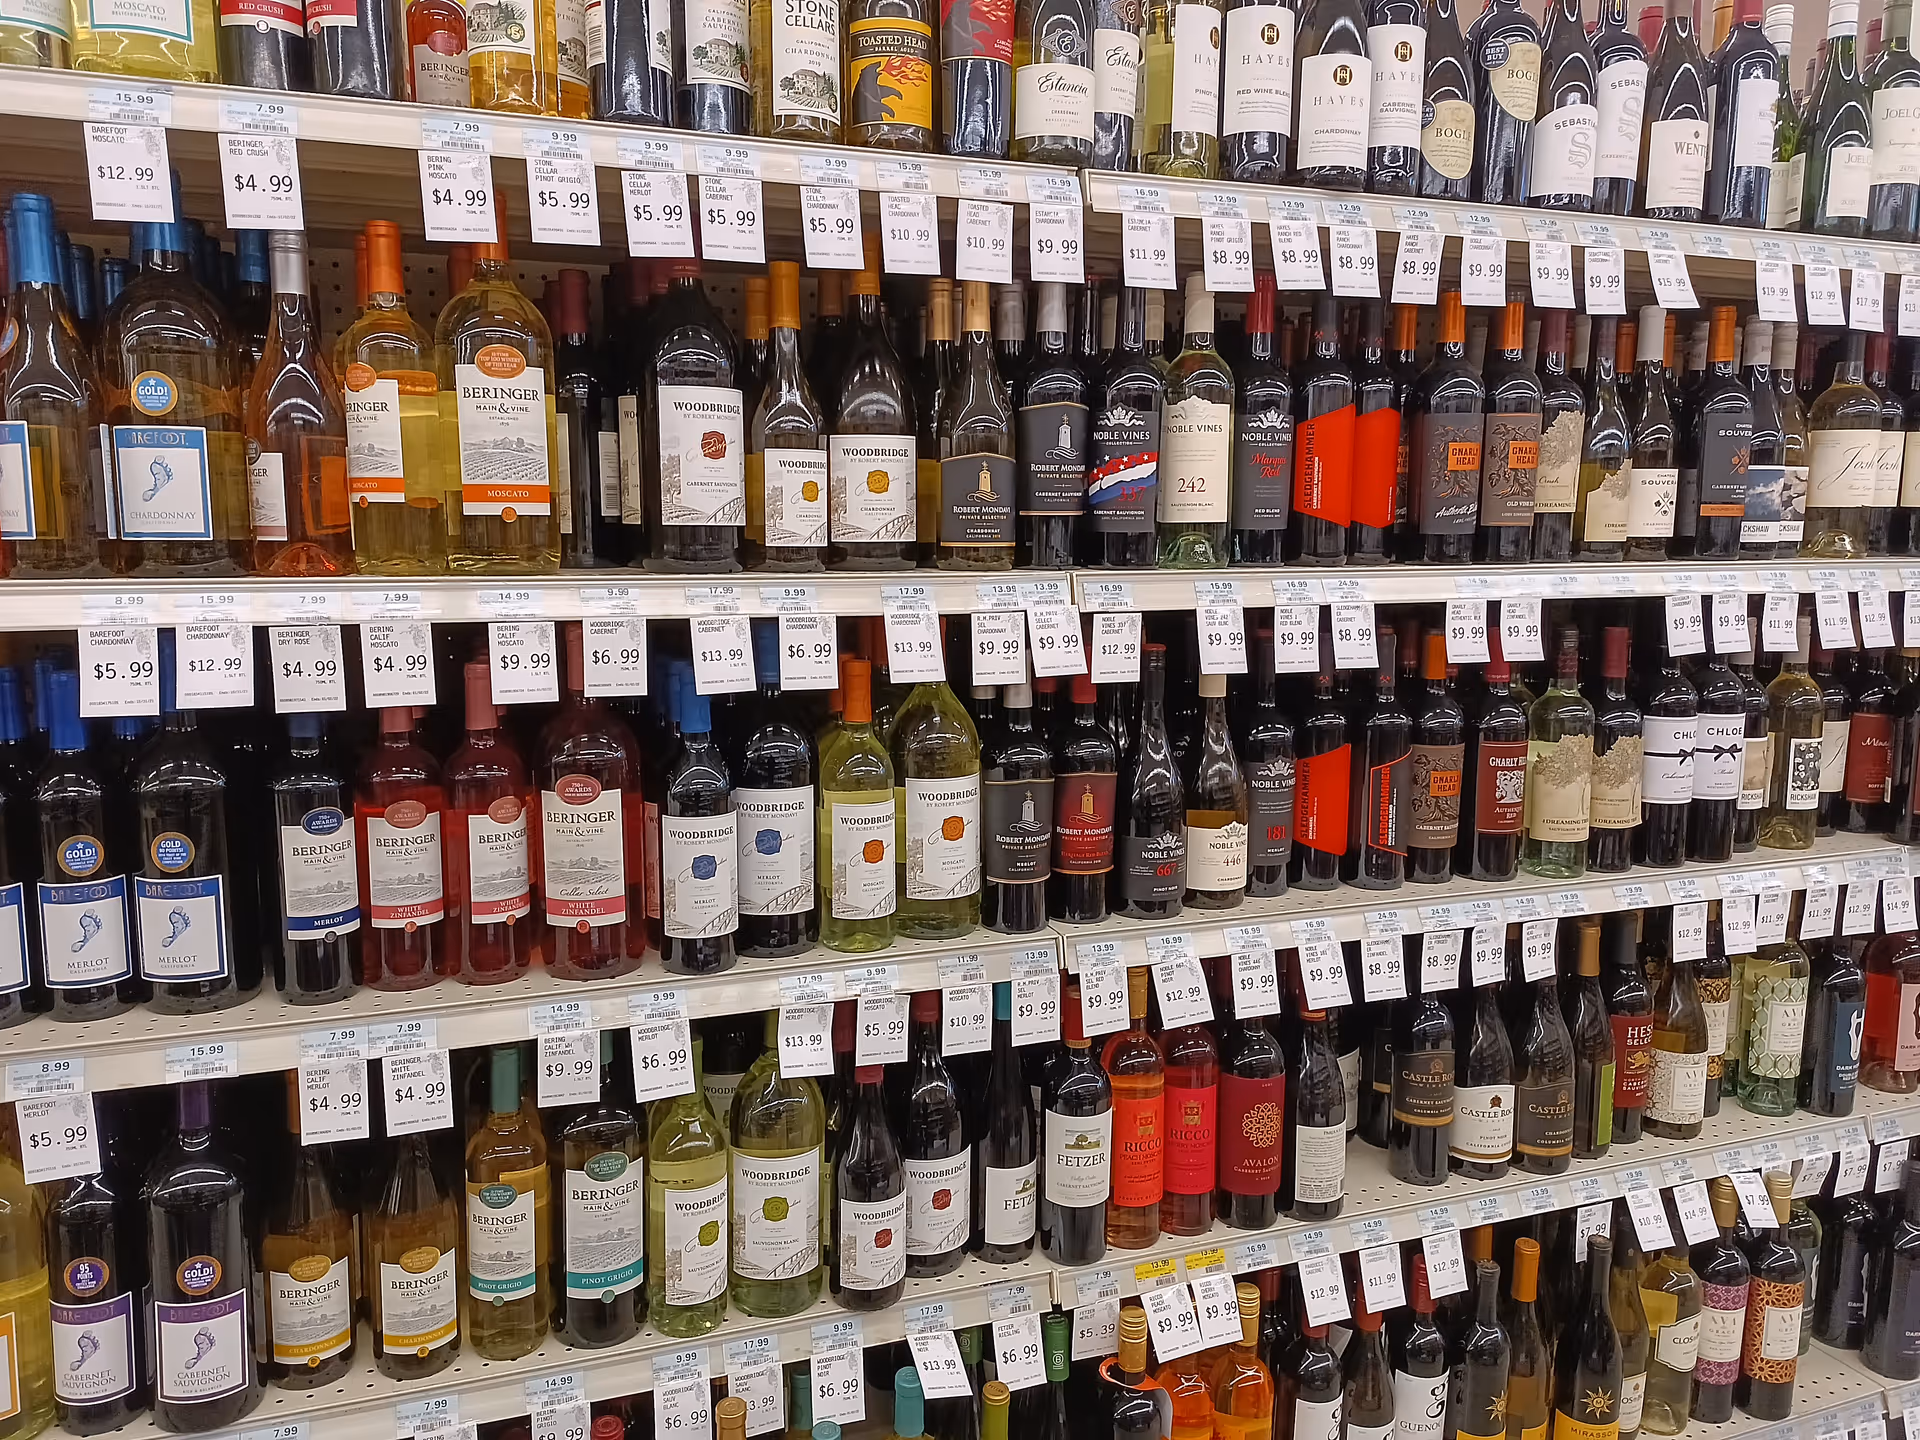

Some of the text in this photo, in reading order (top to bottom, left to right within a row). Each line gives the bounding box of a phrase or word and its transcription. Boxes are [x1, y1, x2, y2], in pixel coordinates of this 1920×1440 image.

[113, 1, 165, 16] MOSCATO
[239, 2, 284, 16] RED CRUSH
[785, 14, 835, 37] CELLARS
[858, 35, 927, 51] TOASTED HEAD
[1242, 53, 1290, 68] HAYES
[1487, 53, 1504, 61] BUY
[1038, 71, 1089, 97] Estancia
[115, 93, 154, 105] 15.99
[1314, 95, 1364, 107] HAYES
[256, 104, 284, 115] 7.99
[92, 126, 128, 136] BAREFOOT
[551, 132, 577, 142] 9.99
[1435, 127, 1472, 140] BOGLE
[93, 135, 125, 144] MOSCATO
[228, 140, 265, 148] BERINGER
[229, 148, 269, 157] RED CRUSH
[97, 166, 154, 183] $12.99
[429, 172, 457, 180] MOSCATO
[234, 174, 293, 193] $4.99
[433, 188, 487, 208] $4.99
[629, 188, 652, 196] MERLOT
[1135, 188, 1159, 198] 16.99
[539, 191, 590, 210] $5.99
[633, 204, 683, 222] $5.99
[707, 210, 755, 227] $5.99
[809, 218, 854, 235] $5.99
[891, 228, 930, 243] $10.99
[966, 237, 1005, 251] $10.99
[1037, 239, 1078, 255] $9.99
[1129, 249, 1166, 262] $11.99
[1212, 250, 1250, 265] $8.99
[1282, 250, 1318, 264] $8.99
[1339, 256, 1375, 270] $8.99
[1402, 261, 1437, 275] $8.99
[1468, 264, 1503, 278] $9.99
[1537, 267, 1569, 281] $9.99
[1589, 275, 1620, 289] $9.99
[1658, 278, 1685, 288] $15.99
[1762, 287, 1788, 297] $19.99
[1810, 291, 1836, 300] $12.99
[1856, 297, 1880, 308] $17.99
[138, 385, 168, 395] GOLD!
[462, 386, 540, 401] BERINGER
[1093, 431, 1150, 441] NOBLE VINES
[1167, 424, 1223, 434] NOBLE VINES
[1242, 433, 1292, 442] NOBLE VINES
[841, 447, 909, 457] WOODBRIDGE
[1304, 422, 1315, 509] SLEDGEHAMMER
[1177, 477, 1207, 493] 242
[1118, 487, 1147, 501] 337
[130, 511, 196, 520] CHARDONNAY
[899, 587, 924, 596] 17.99
[1100, 584, 1122, 592] 16.99
[200, 595, 234, 604] 15.99
[1674, 616, 1701, 630] $9.99
[1719, 615, 1745, 627] $9.99
[1769, 620, 1793, 629] $11.99
[1824, 617, 1848, 626] $11.99
[1865, 613, 1886, 623] $12.99
[90, 630, 125, 638] BAREFOOT
[278, 630, 310, 638] BERINGER
[1338, 628, 1372, 642] $8.99
[1452, 626, 1484, 640] $9.99
[1507, 624, 1538, 638] $9.99
[90, 637, 134, 646] CHARDONNAY
[1039, 635, 1078, 651] $9.99
[1208, 632, 1243, 647] $9.99
[1281, 631, 1314, 646] $9.99
[788, 643, 831, 659] $6.99
[894, 641, 932, 653] $13.99
[979, 641, 1019, 655] $9.99
[1102, 643, 1136, 656] $12.99
[500, 653, 551, 670] $9.99
[592, 649, 639, 666] $6.99
[701, 649, 743, 662] $13.99
[189, 658, 242, 672] $12.99
[283, 660, 337, 678] $4.99
[373, 654, 427, 672] $4.99
[94, 661, 154, 680] $5.99
[1707, 726, 1742, 737] CHLOE
[1489, 756, 1517, 767] GNARLY
[565, 786, 592, 794] AWARDS
[918, 787, 978, 802] WOODBRIDGE
[1380, 767, 1390, 845] SLEDGEHAMMER
[547, 810, 616, 824] BERINGER
[547, 810, 616, 824] BERINGER
[669, 826, 734, 839] WOODBRIDGE
[1266, 825, 1287, 840] 181
[66, 848, 96, 859] GOLD!
[292, 839, 352, 857] BERINGER
[1222, 853, 1242, 866] 446
[1157, 863, 1177, 876] 667
[560, 887, 608, 898] Cellar Select
[562, 907, 605, 916] ZINFANDEL
[1848, 904, 1870, 915] $12.99
[314, 916, 343, 926] MERLOT
[1761, 913, 1784, 924] $11.99
[1678, 927, 1702, 939] $12.99
[68, 958, 109, 970] MERLOT
[1368, 961, 1400, 975] $8.99
[1165, 987, 1201, 1002] $12.99
[551, 1003, 579, 1013] 14.99
[1018, 1001, 1056, 1018] $9.99
[864, 1021, 904, 1037] $5.99
[785, 1034, 822, 1048] $13.99
[641, 1049, 687, 1070] $6.99
[392, 1071, 426, 1080] ZINFANDEL
[546, 1060, 593, 1078] $9.99
[1402, 1070, 1440, 1083] CASTLE
[395, 1082, 446, 1103] $4.99
[23, 1101, 57, 1112] BAREFOOT
[309, 1092, 361, 1113] $4.99
[29, 1125, 88, 1149] $5.99
[1124, 1138, 1161, 1152] RICCO
[1057, 1152, 1106, 1167] FETZER
[1243, 1155, 1278, 1168] AVALON
[741, 1166, 811, 1179] WOODBRIDGE
[1745, 1196, 1770, 1207] $7.99
[472, 1212, 527, 1226] BERINGER
[1684, 1208, 1707, 1219] $14.99
[79, 1263, 90, 1274] 95
[581, 1269, 633, 1285] PINOT GRIGIO
[1310, 1285, 1339, 1300] $12.99
[833, 1322, 853, 1332] 9.99
[1158, 1312, 1194, 1332] $9.99
[1079, 1323, 1115, 1339] $5.39
[1672, 1337, 1694, 1345] CLOS
[1002, 1345, 1038, 1364] $6.99
[174, 1372, 230, 1387] SAUVIGNON
[177, 1365, 226, 1380] CABERNET
[819, 1379, 859, 1399] $6.99
